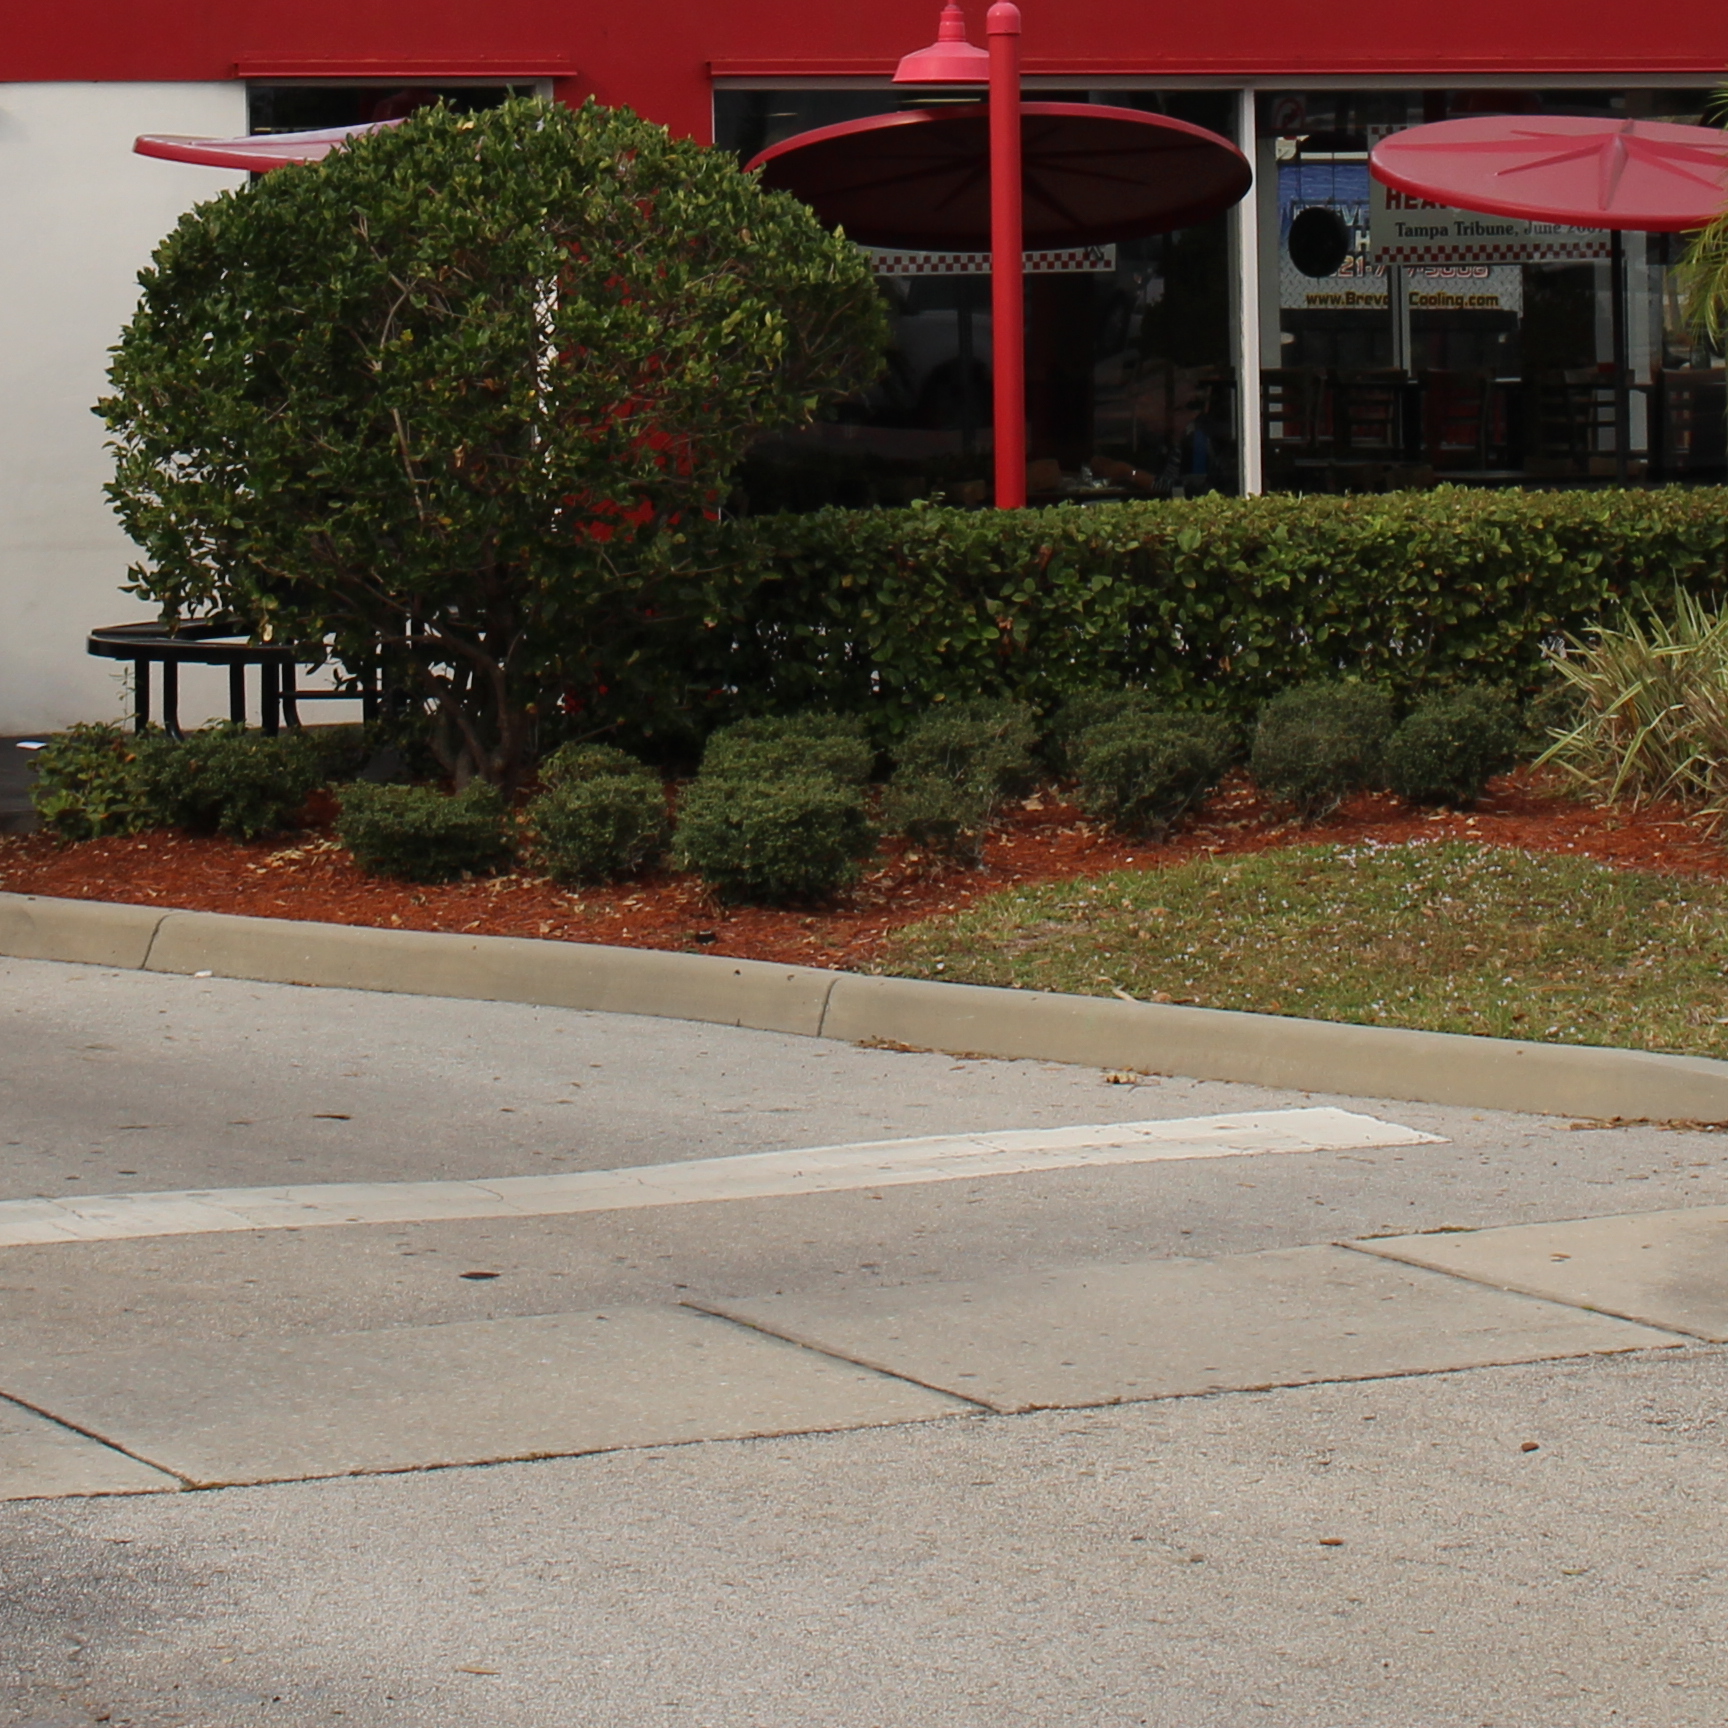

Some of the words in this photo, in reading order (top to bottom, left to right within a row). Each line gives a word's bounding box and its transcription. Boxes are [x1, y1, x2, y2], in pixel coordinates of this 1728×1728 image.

[1395, 222, 1449, 240] Tampa
[1453, 220, 1519, 238] Tribune,
[1524, 220, 1562, 235] June
